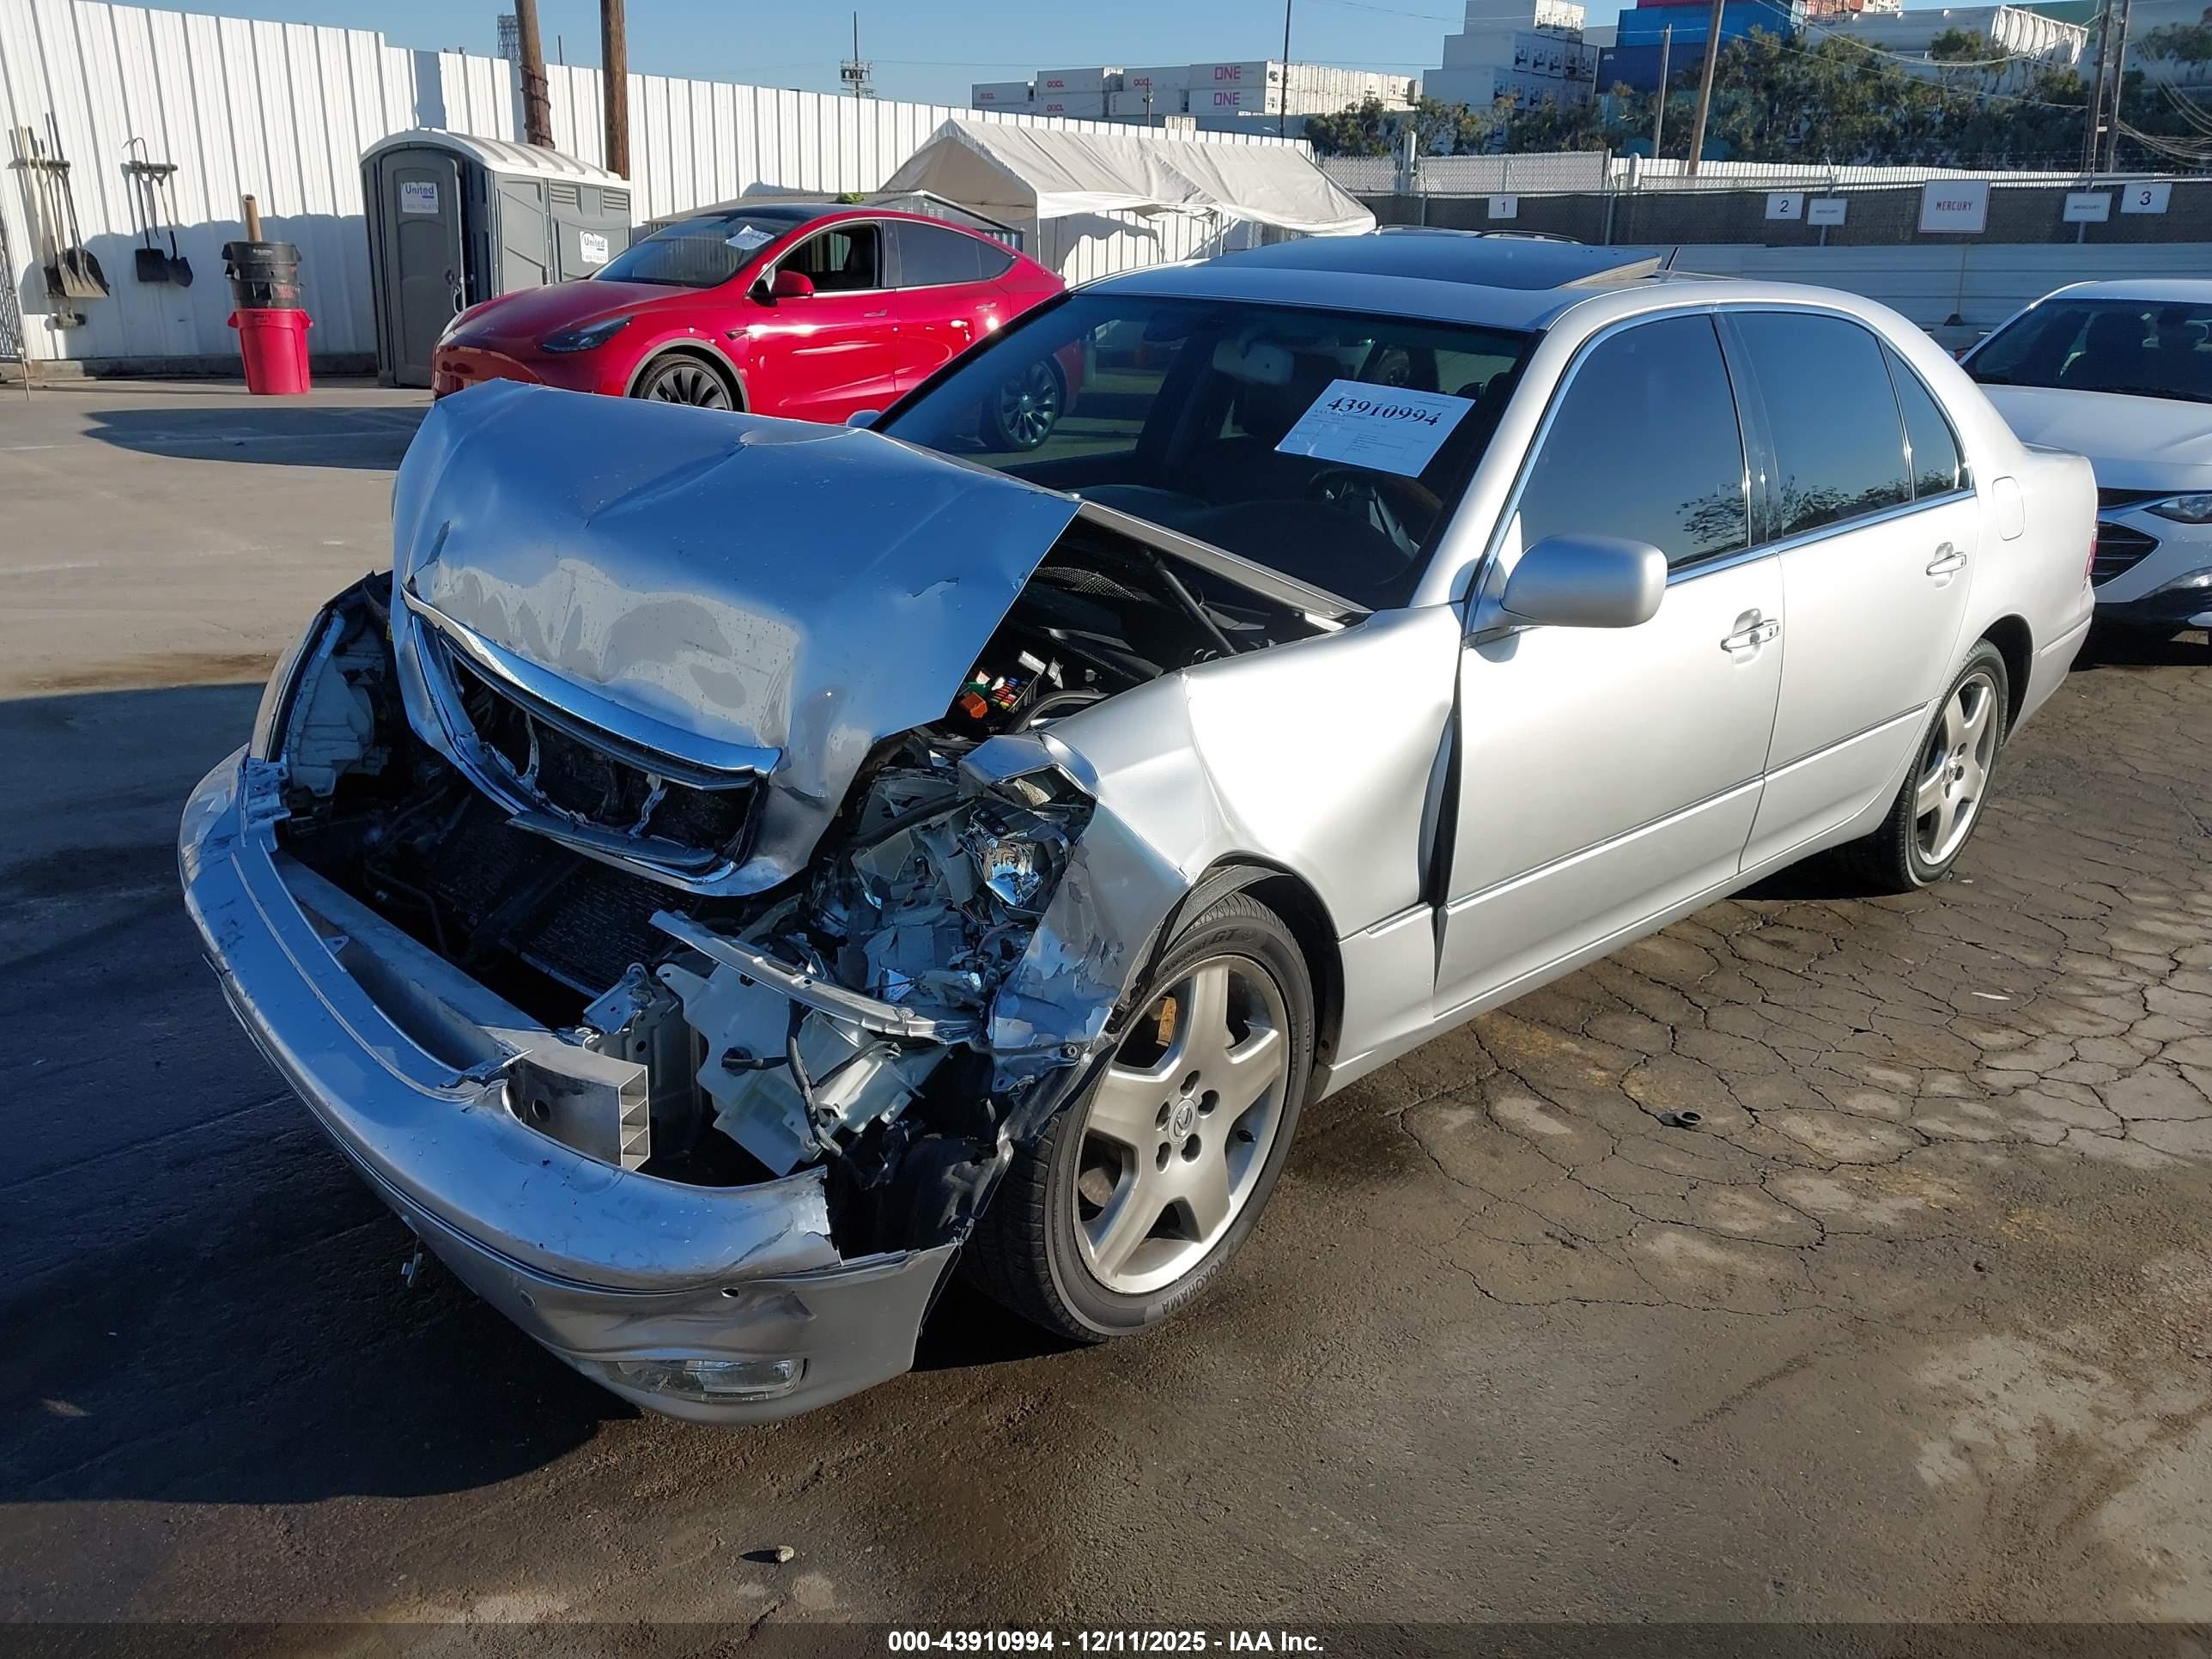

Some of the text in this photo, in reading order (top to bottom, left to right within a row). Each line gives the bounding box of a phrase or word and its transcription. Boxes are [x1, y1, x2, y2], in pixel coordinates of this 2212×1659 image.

[1214, 66, 1241, 80] ONE
[1213, 92, 1240, 106] ONE
[405, 184, 434, 195] United
[2140, 191, 2152, 205] 3
[1500, 200, 1506, 213] 1
[1780, 200, 1790, 213] 2
[1936, 200, 1973, 212] MERCURY
[584, 236, 605, 247] United
[1327, 397, 1443, 426] 43910994
[1209, 928, 1239, 945] GT
[1161, 1259, 1223, 1315] YOKOHAMA
